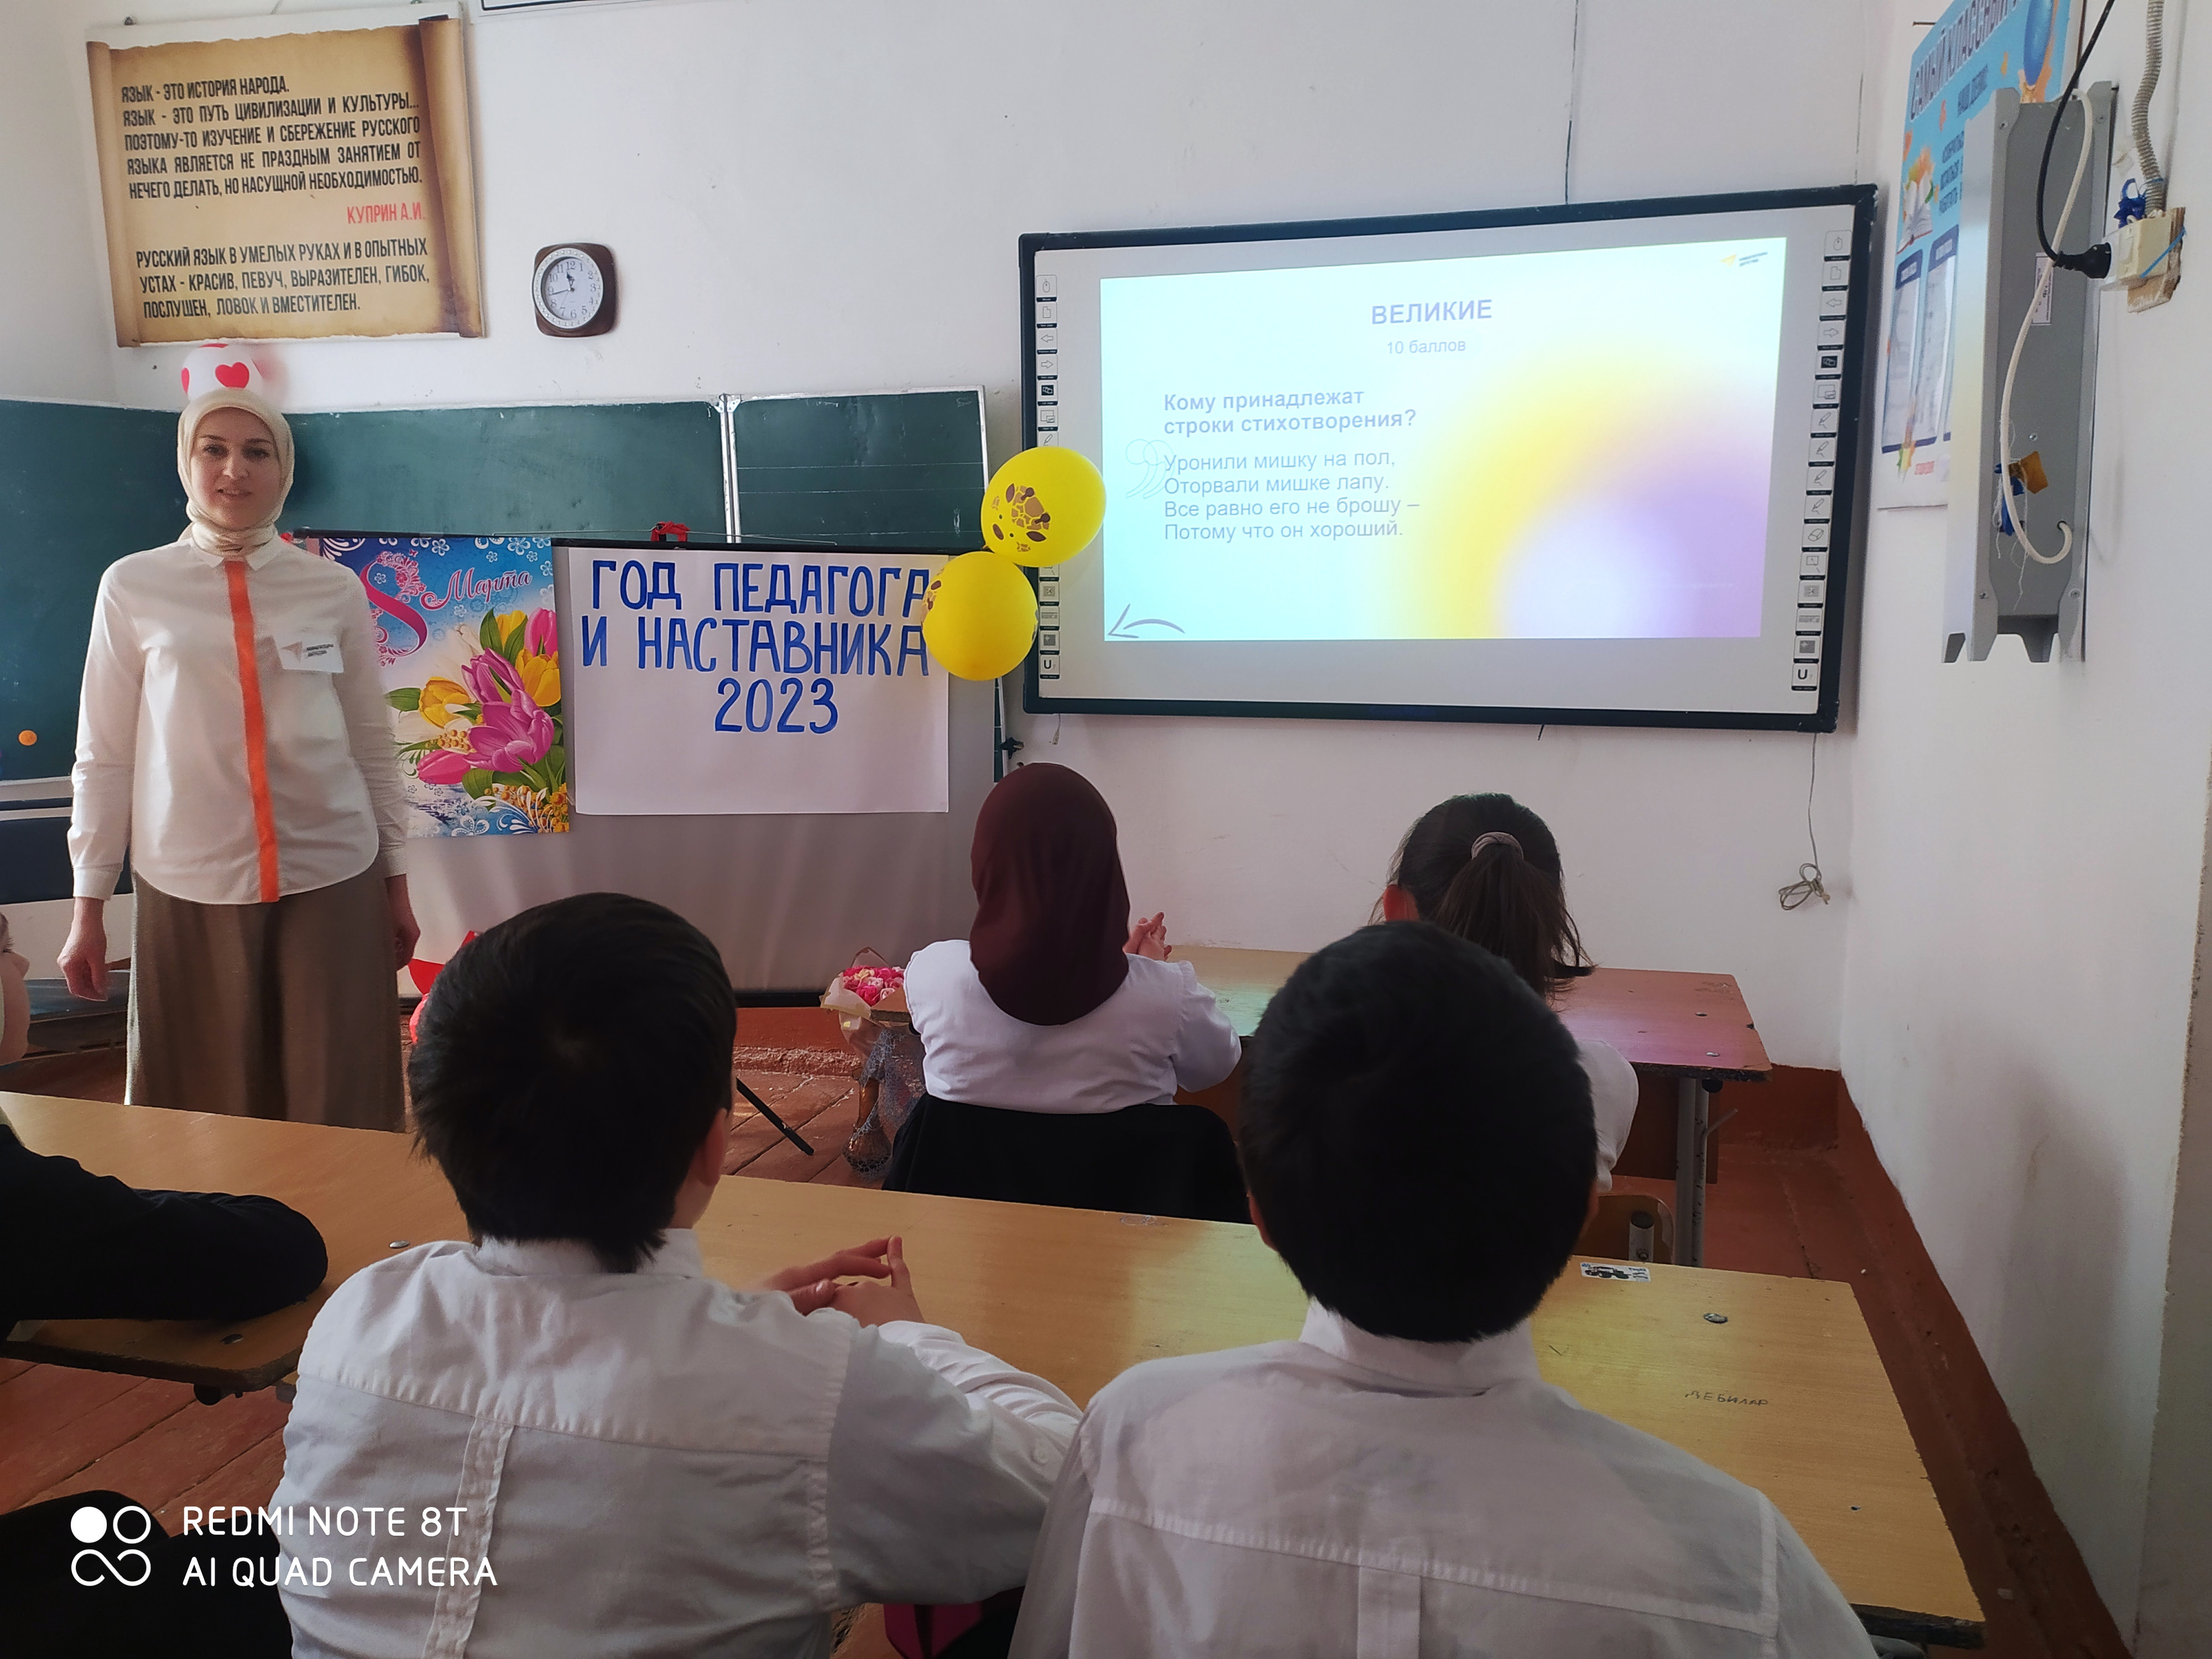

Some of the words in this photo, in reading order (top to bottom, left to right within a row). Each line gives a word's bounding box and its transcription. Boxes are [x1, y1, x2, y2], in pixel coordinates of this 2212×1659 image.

[122, 85, 154, 103] ЯЗЫК
[163, 82, 184, 101] ЭТО
[187, 79, 237, 99] ИСТОРИЯ
[239, 75, 289, 95] НАРОДА.
[123, 109, 156, 127] ЯЗЫК
[173, 106, 194, 124] ЭТО
[199, 104, 229, 122] ПУТЬ
[235, 98, 321, 121] ЦИВИЛИЗАЦИИ
[328, 97, 336, 114] И
[342, 92, 419, 113] КУЛЬТУРЫ...
[124, 131, 197, 151] ПОЭТОМУ-ТО
[202, 127, 262, 147] ИЗУЧЕНИЕ
[267, 126, 275, 143] И
[280, 121, 356, 142] СБЕРЕЖЕНИЕ
[362, 116, 420, 137] РУССКОГО
[127, 157, 168, 175] ЯЗЫКА
[174, 153, 233, 174] ЯВЛЯЕТСЯ
[241, 152, 255, 169] НЕ
[262, 147, 330, 168] ПРАЗДНЫМ
[337, 143, 400, 164] ЗАНЯТИЕМ
[408, 140, 420, 159] ОТ
[129, 181, 170, 199] НЕЧЕГО
[173, 179, 222, 199] ДЕЛАТЬ,
[225, 178, 239, 195] НО
[241, 171, 306, 194] НАСУЩНОЙ
[309, 166, 422, 190] НЕОБХОДИМОСТЬЮ.
[347, 203, 397, 224] КУПРИН
[400, 202, 425, 221] А.И.
[136, 246, 191, 268] РУССКИЙ
[194, 247, 226, 267] ЯЗЫК
[229, 247, 237, 264] В
[239, 244, 296, 264] УМЕЛЫХ
[299, 242, 340, 262] РУКАХ
[343, 242, 351, 259] И
[354, 241, 362, 258] В
[364, 237, 427, 258] ОПЫТНЫХ
[557, 264, 564, 273] 11
[566, 260, 576, 270] 12
[580, 263, 583, 272] 1
[588, 270, 593, 279] 2
[139, 275, 177, 294] УСТАХ
[189, 272, 238, 291] КРАСИВ,
[242, 270, 287, 290] ПЕВУЧ,
[291, 266, 381, 288] ВЫРАЗИТЕЛЕН,
[385, 264, 430, 284] ГИБОК,
[549, 273, 558, 283] 10
[590, 283, 596, 293] 3
[143, 299, 211, 318] ПОСЛУШЕН,
[216, 297, 257, 315] ЛОВОК
[260, 296, 269, 314] И
[273, 293, 361, 314] ВМЕСТИТЕЛЕН.
[570, 310, 577, 319] 6
[582, 305, 587, 315] 5
[1371, 299, 1493, 325] ВЕЛИКИЕ
[1387, 341, 1404, 354] 10
[1408, 339, 1467, 354] баллов
[1164, 393, 1215, 414] Кому
[1223, 390, 1364, 413] принадлежат
[1164, 419, 1234, 437] строки
[1240, 409, 1416, 432] стихотворения?
[1164, 453, 1248, 475] Уронили
[1254, 452, 1317, 472] мишку
[1324, 453, 1347, 467] на
[1354, 451, 1395, 467] пол,
[1164, 478, 1259, 497] Оторвали
[1266, 477, 1330, 492] мишке
[1336, 476, 1389, 493] лапу.
[1165, 501, 1199, 517] Все
[1206, 501, 1262, 520] равно
[1270, 501, 1300, 519] его
[1307, 500, 1329, 515] не
[1337, 497, 1401, 517] брошу
[1165, 523, 1236, 543] Потому
[1242, 523, 1274, 539] что
[1281, 523, 1303, 538] он
[1310, 520, 1403, 541] хороший.
[420, 567, 532, 610] Марта
[593, 560, 682, 610] ГОД
[714, 562, 930, 618] ПЕДАГОГА
[582, 615, 607, 666] И
[638, 616, 929, 676] НАСТАВНИКА
[714, 677, 838, 734] 2023
